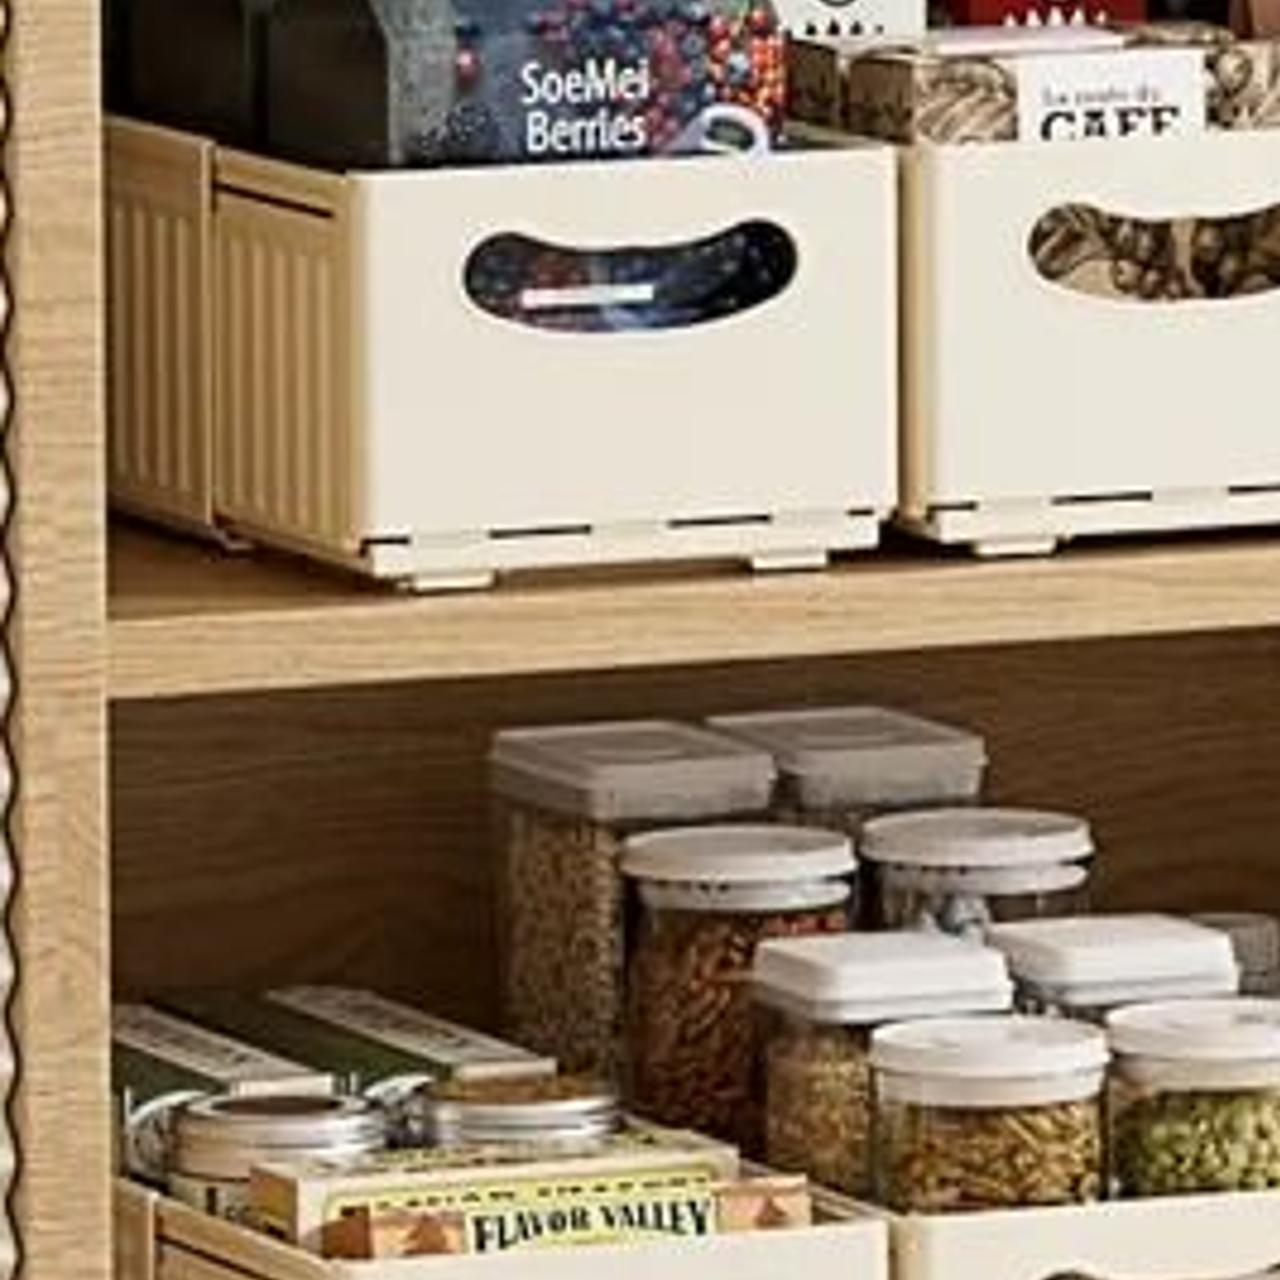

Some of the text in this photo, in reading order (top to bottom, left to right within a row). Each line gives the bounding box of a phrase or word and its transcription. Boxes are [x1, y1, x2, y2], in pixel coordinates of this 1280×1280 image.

[521, 58, 650, 104] SoeMei
[526, 108, 646, 153] Berries
[473, 1198, 711, 1252] FLAVOR VALLEY
